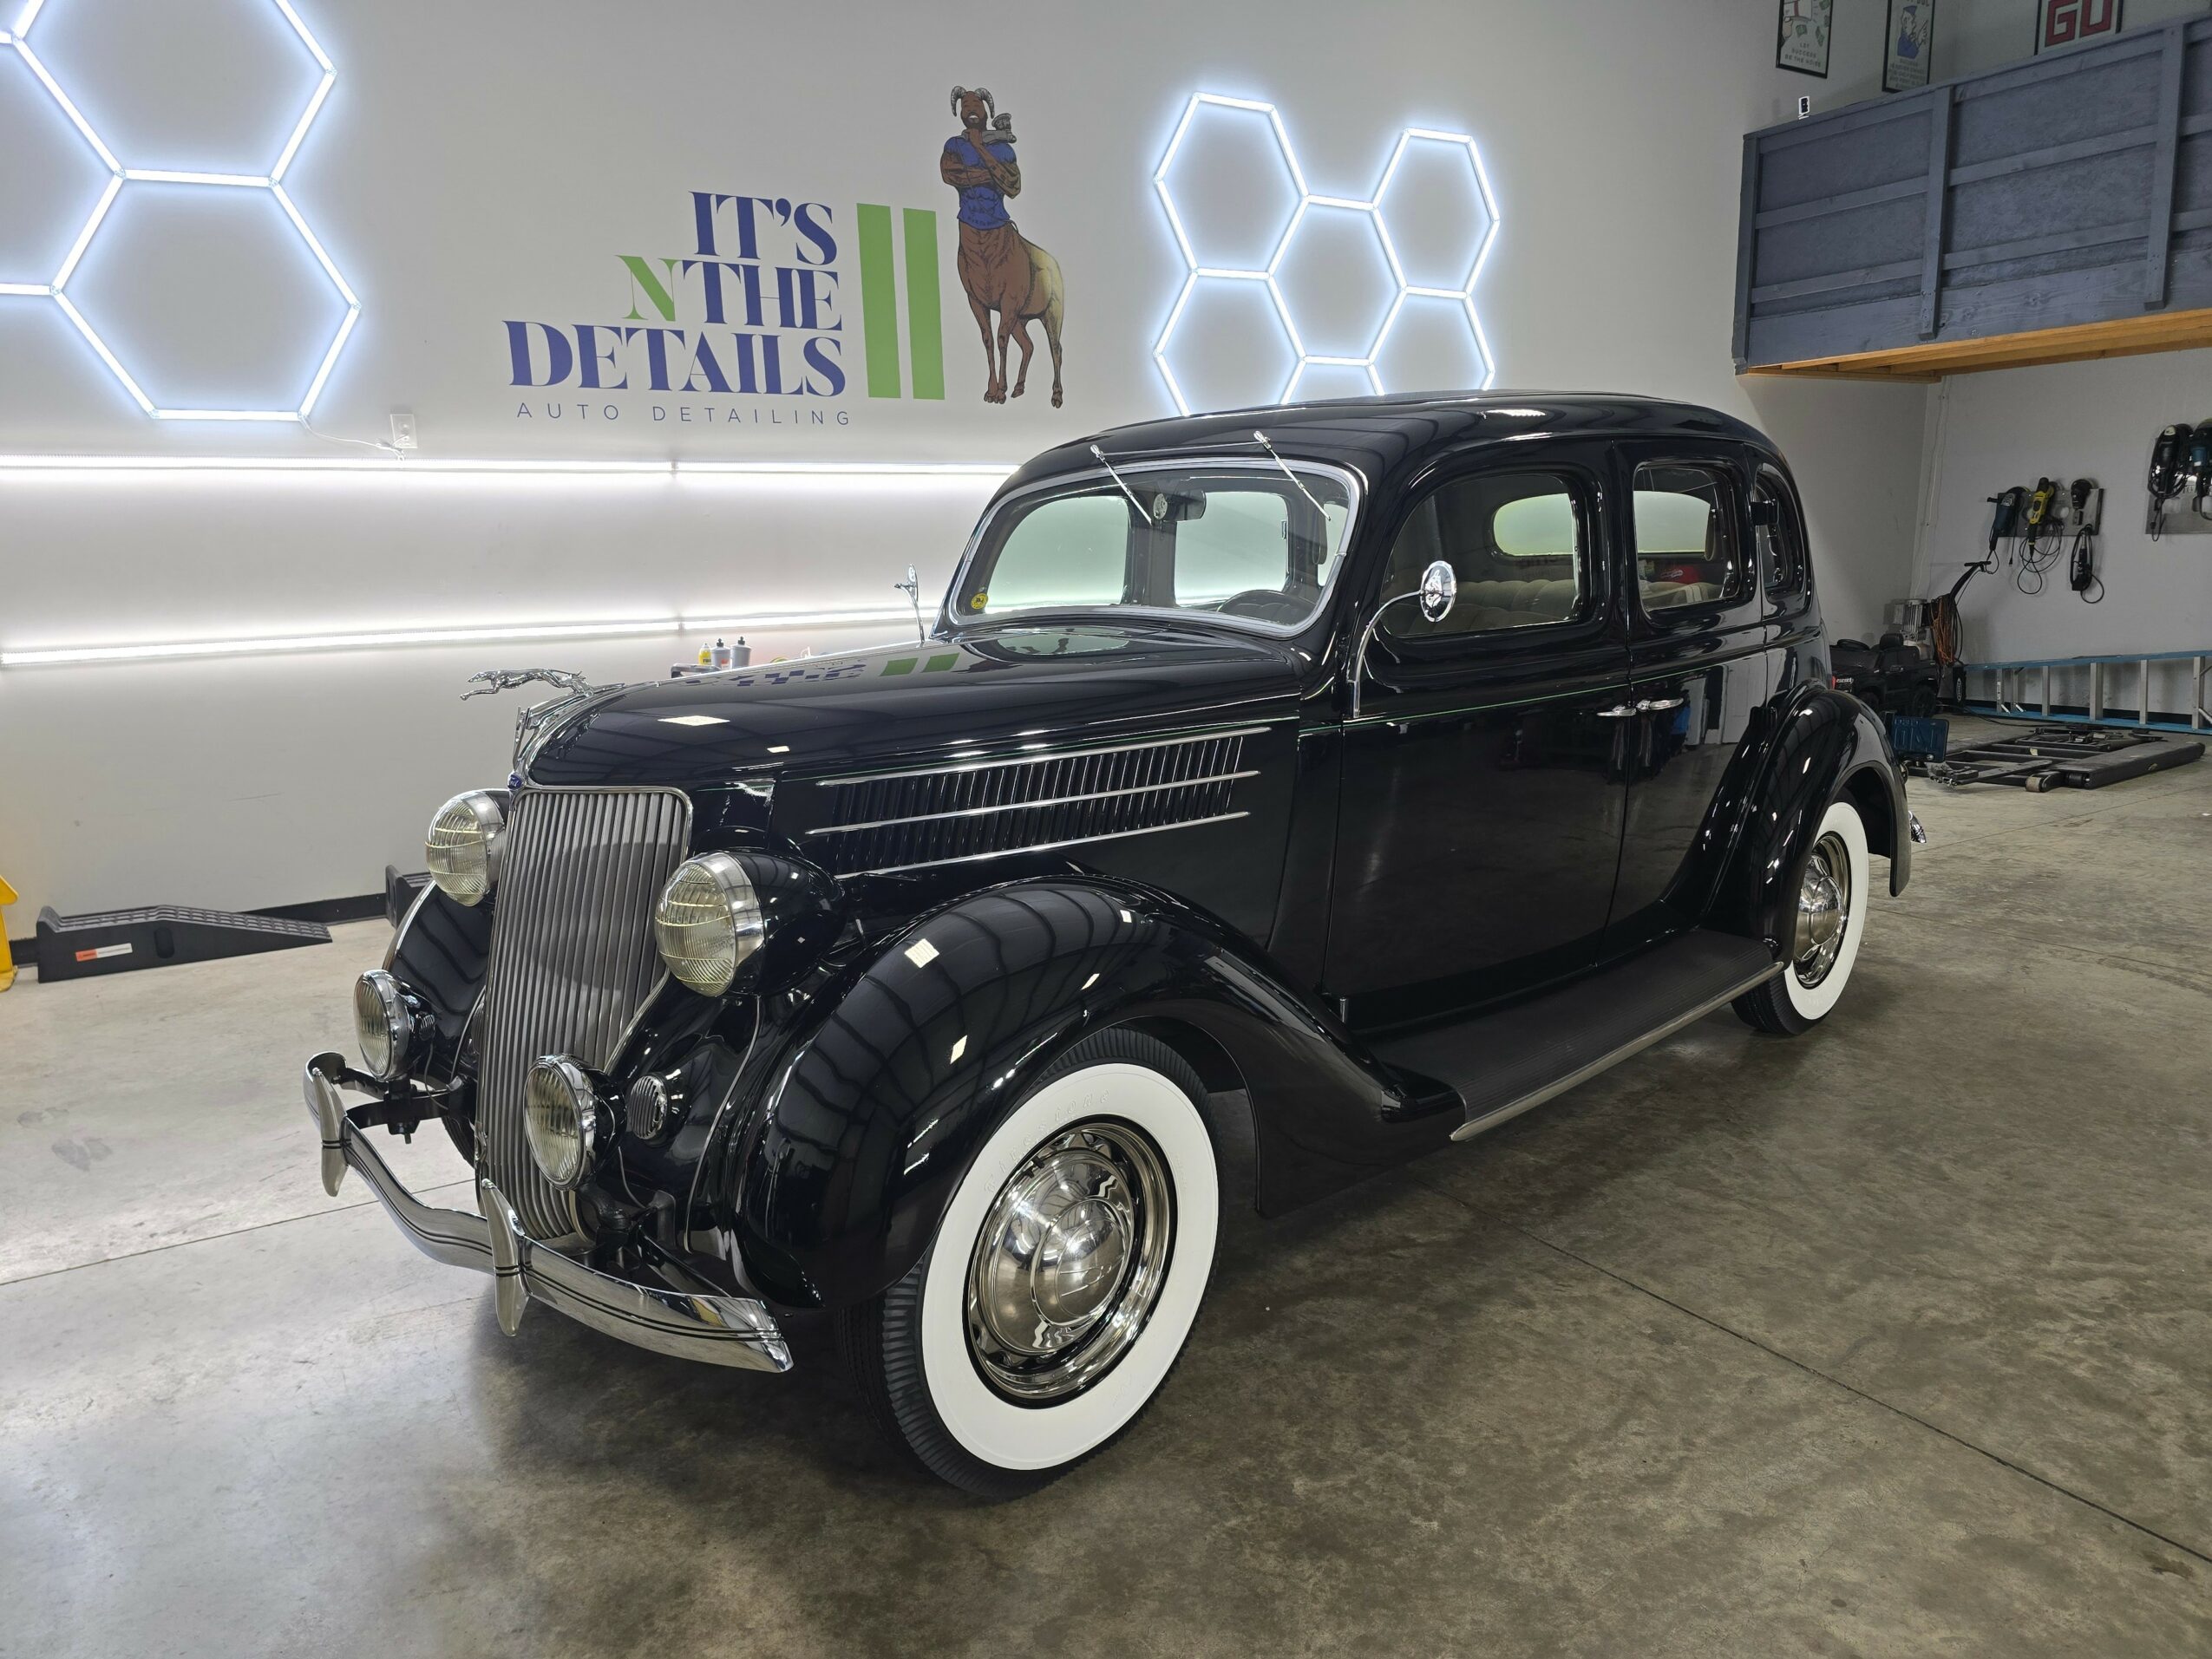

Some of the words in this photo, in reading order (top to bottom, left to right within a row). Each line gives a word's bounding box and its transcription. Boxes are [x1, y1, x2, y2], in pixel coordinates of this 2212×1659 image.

[688, 191, 838, 265] IT'S
[501, 320, 846, 397] DETAILS
[517, 402, 618, 421] AUTO
[652, 406, 849, 426] DETAILING
